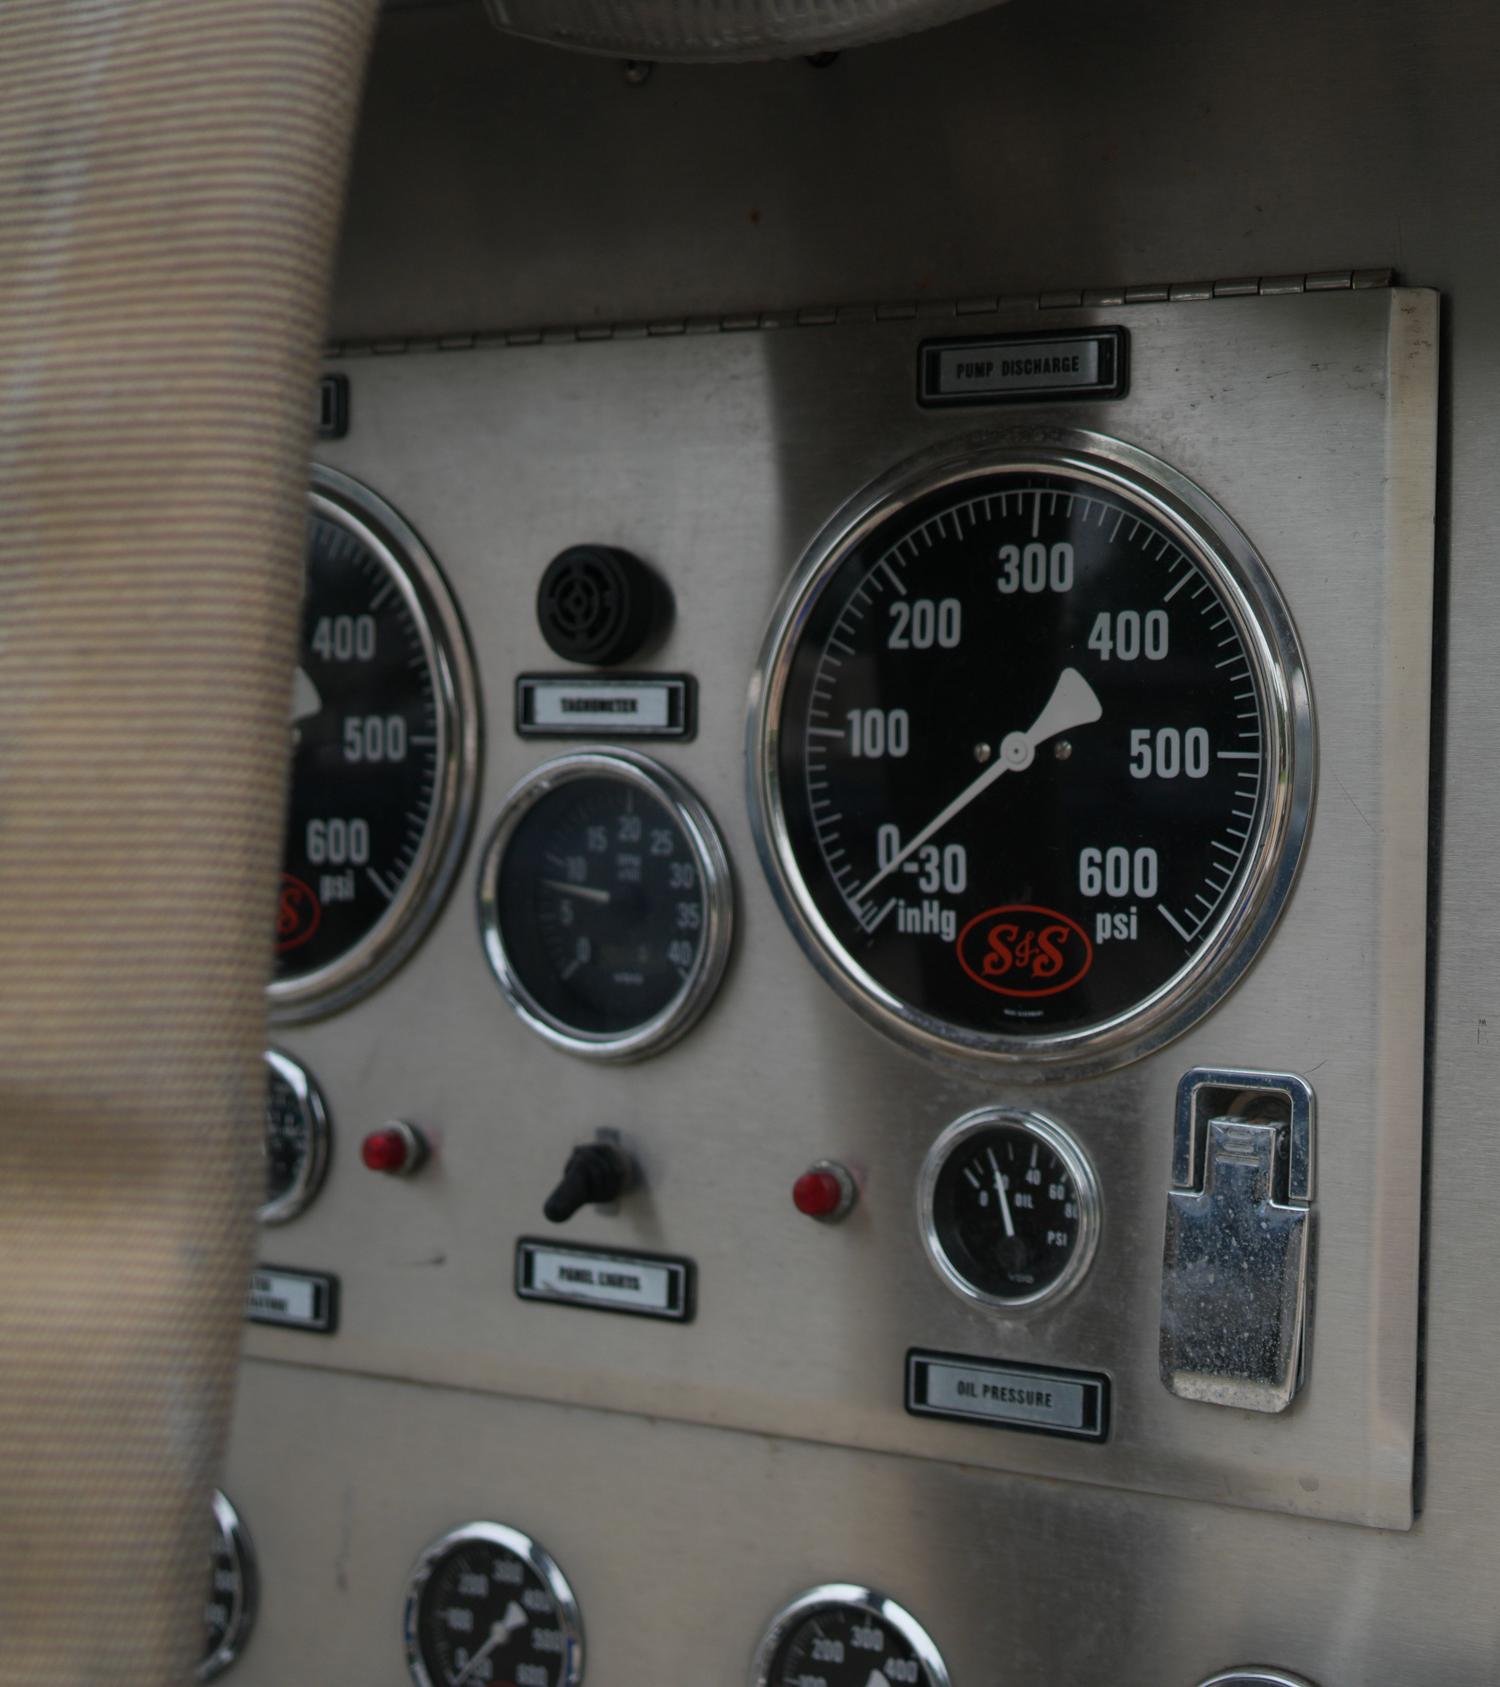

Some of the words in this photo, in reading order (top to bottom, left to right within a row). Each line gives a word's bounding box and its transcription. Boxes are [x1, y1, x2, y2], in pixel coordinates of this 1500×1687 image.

[956, 361, 993, 379] PUMP
[1002, 355, 1080, 377] DISCHARGE
[997, 542, 1074, 594] 300
[311, 616, 376, 661] 400
[888, 598, 961, 649] 200
[1088, 609, 1169, 661] 400
[343, 715, 407, 763] 500
[847, 709, 910, 758] 100
[1129, 728, 1210, 779] 500
[306, 818, 369, 865] 600
[617, 815, 642, 843] 20
[650, 829, 675, 856] 25
[669, 861, 694, 890] 30
[1079, 847, 1158, 897] 600
[320, 871, 355, 905] psi
[676, 902, 701, 931] 35
[897, 898, 957, 943] inHg
[1096, 903, 1138, 945] psi
[981, 924, 1070, 979] S&S
[1025, 1168, 1042, 1187] 40
[1048, 1183, 1065, 1201] 60
[978, 1189, 990, 1208] 0
[1014, 1192, 1035, 1210] OIL
[1046, 1230, 1068, 1248] PSI
[559, 1265, 593, 1285] PANEL
[957, 1380, 977, 1398] OIL
[982, 1384, 1053, 1408] PRESSURE
[850, 1625, 885, 1652] 300
